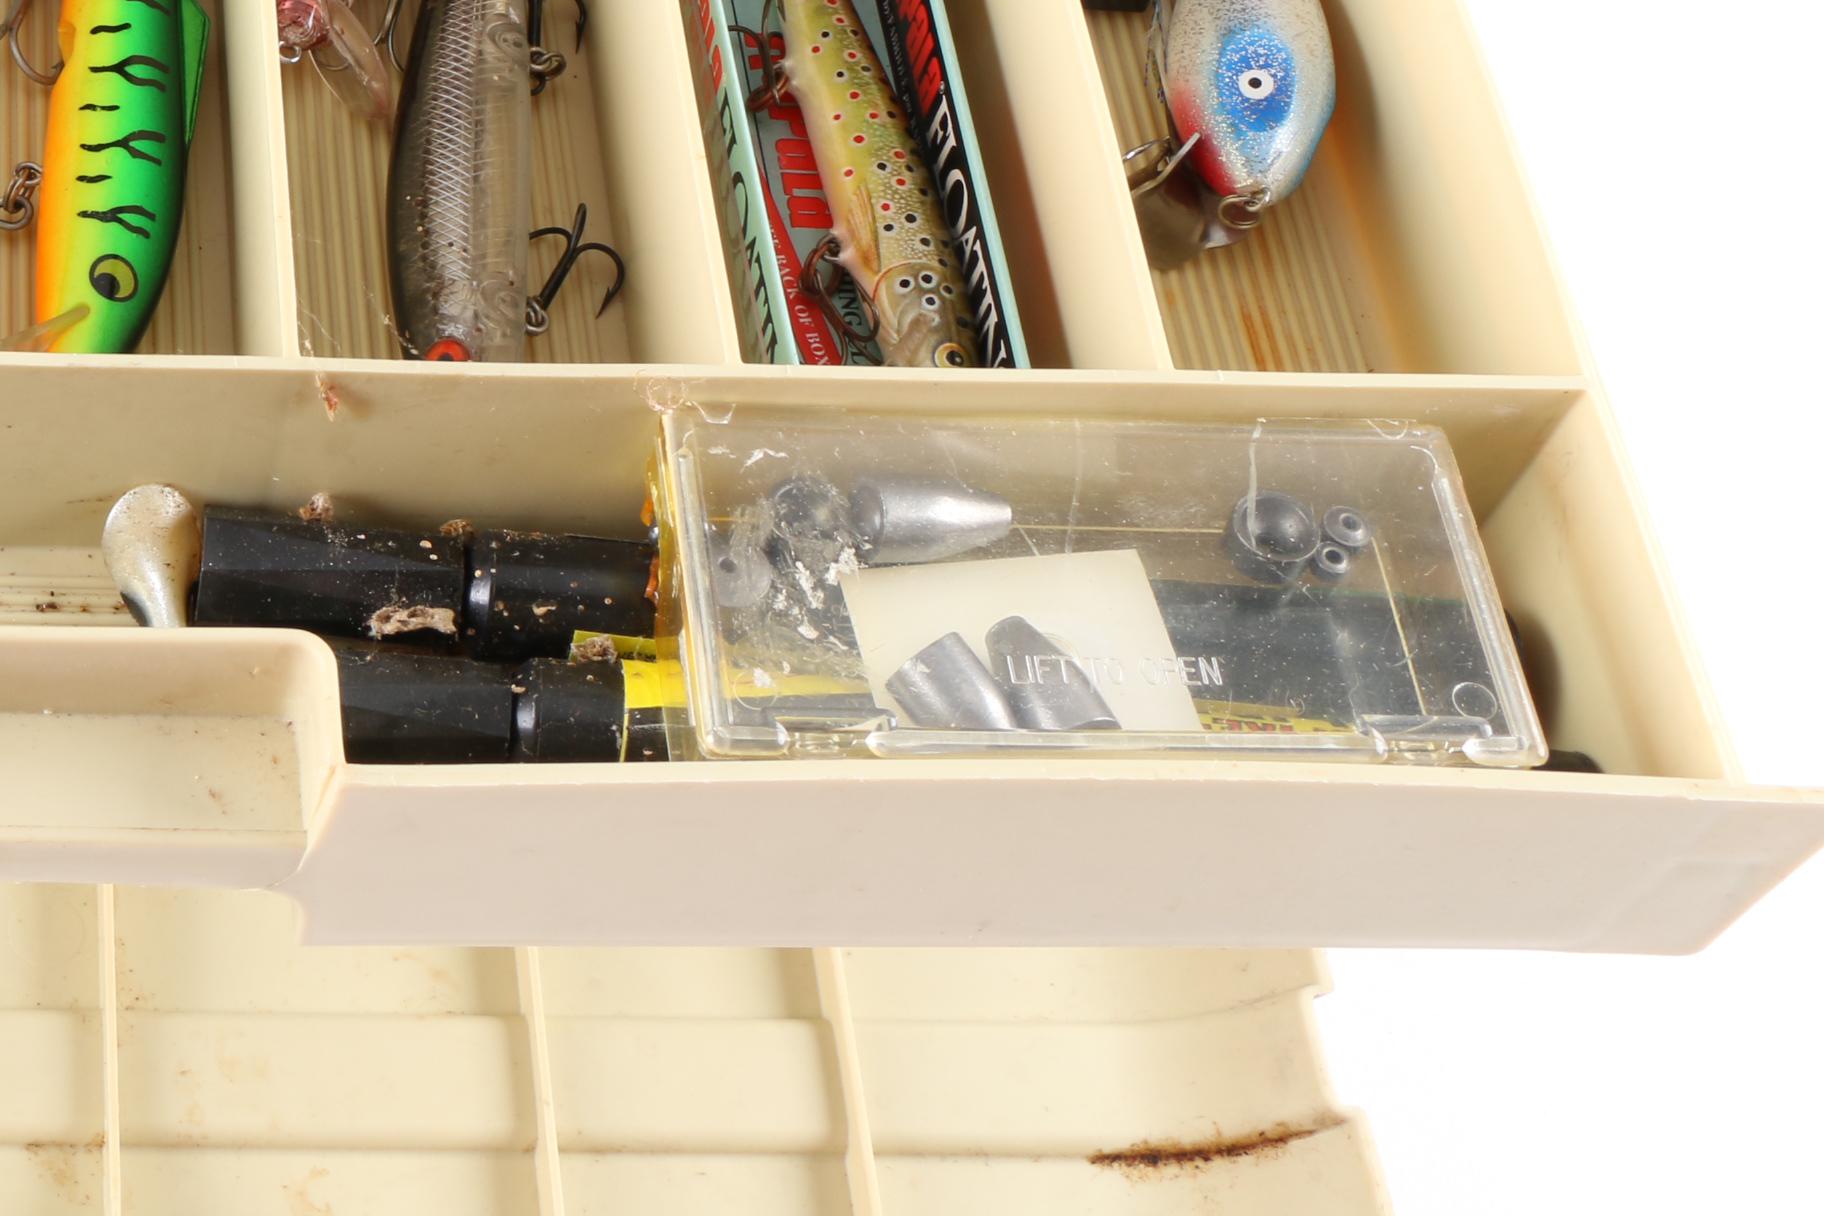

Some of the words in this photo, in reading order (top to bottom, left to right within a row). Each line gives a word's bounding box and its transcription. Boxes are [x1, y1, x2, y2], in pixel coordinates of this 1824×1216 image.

[927, 95, 1007, 368] FLOATIN
[794, 305, 814, 327] OF
[1006, 655, 1076, 684] LIFT
[1082, 657, 1123, 685] TO
[1137, 656, 1226, 685] OPEN
